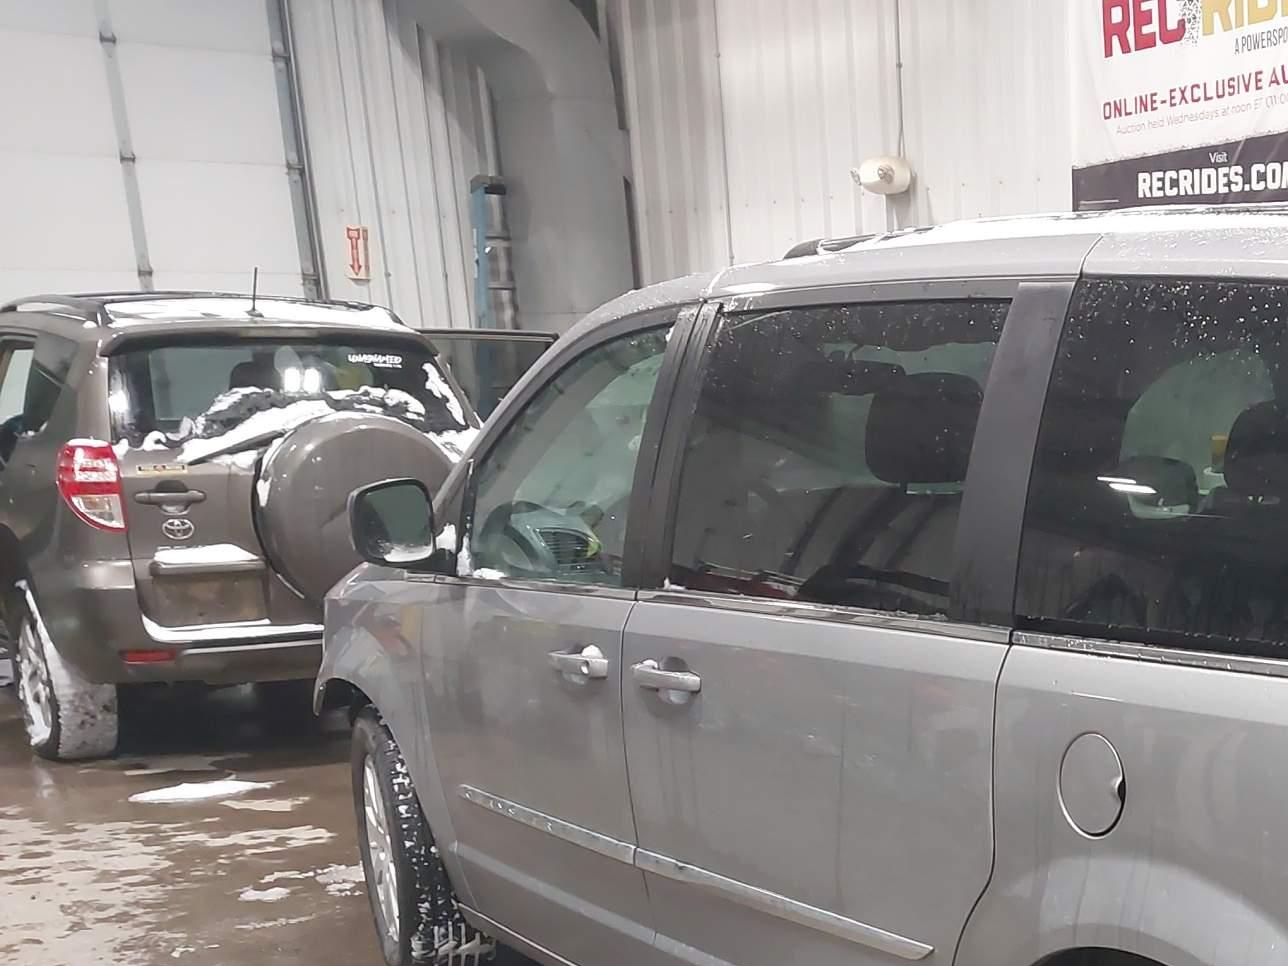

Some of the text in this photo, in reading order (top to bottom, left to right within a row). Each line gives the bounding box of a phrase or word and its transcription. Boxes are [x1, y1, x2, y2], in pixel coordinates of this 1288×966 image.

[1234, 37, 1240, 55] A
[1103, 70, 1264, 120] ONLINE-EXCLUSIVE
[1208, 151, 1229, 163] Visit
